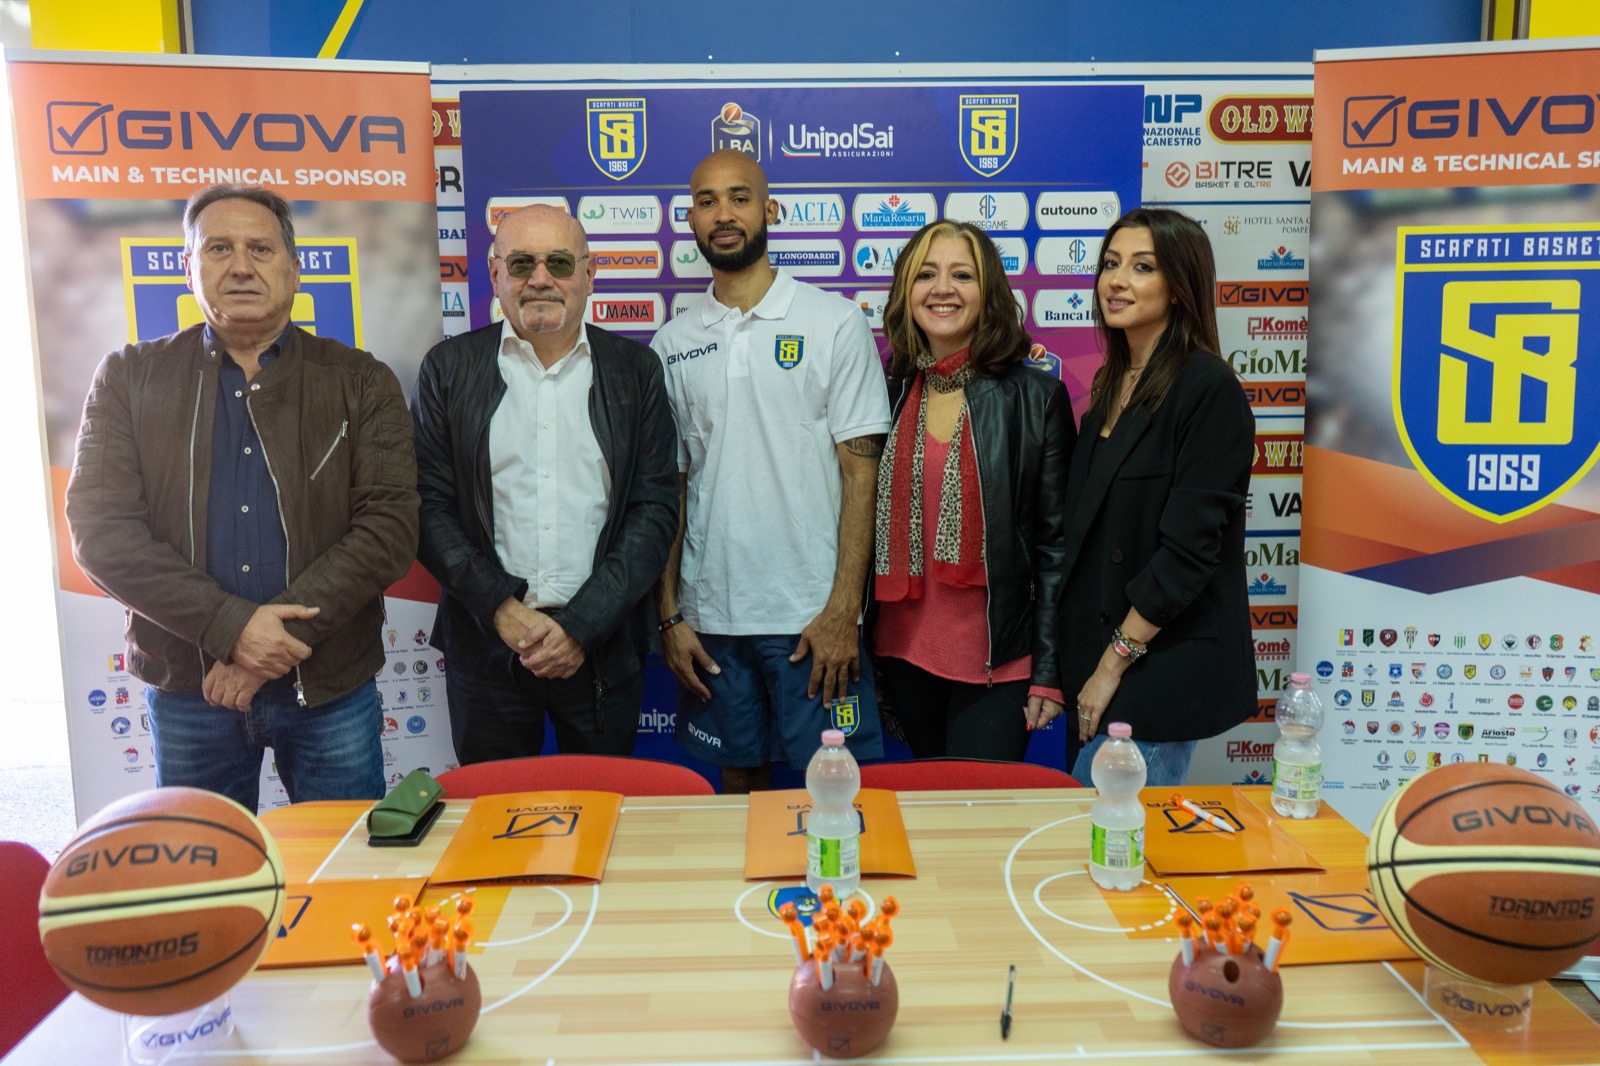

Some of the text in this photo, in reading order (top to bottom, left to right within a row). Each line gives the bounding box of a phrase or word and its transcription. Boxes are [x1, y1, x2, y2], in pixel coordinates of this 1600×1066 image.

[1220, 105, 1279, 133] OLD
[1407, 94, 1600, 139] GIVO
[117, 110, 406, 154] GIVOVA
[789, 122, 894, 158] UnipolSai
[832, 150, 894, 158] ASSICURAZIONI
[608, 160, 628, 172] 1969
[979, 157, 998, 169] 1969
[1195, 161, 1273, 180] BITRE
[1343, 157, 1404, 175] MAIN
[1411, 155, 1427, 173] &
[1434, 152, 1571, 172] TECHNICAL
[52, 165, 407, 187] MAIN & TECHNICAL SPONSOR
[1195, 181, 1230, 189] BASKET
[609, 206, 656, 219] TWIST
[790, 202, 841, 222] ACTA
[1040, 205, 1098, 216] autouno
[1244, 216, 1273, 225] HOTEL
[1276, 216, 1304, 225] SANTA
[779, 252, 835, 260] LONGOBARDI
[1420, 238, 1510, 258] SCAFATI
[596, 256, 656, 266] GIVOVA
[596, 303, 649, 320] UMANA
[1044, 310, 1081, 321] Banca
[667, 342, 718, 365] GIVOVA
[1467, 454, 1541, 492] 1969
[1482, 729, 1516, 737] Ariosto
[506, 805, 583, 813] GIVOVA
[1453, 805, 1596, 836] GIVOVA
[66, 844, 218, 878] GIVOVA
[820, 1001, 881, 1012] GIVOVA
